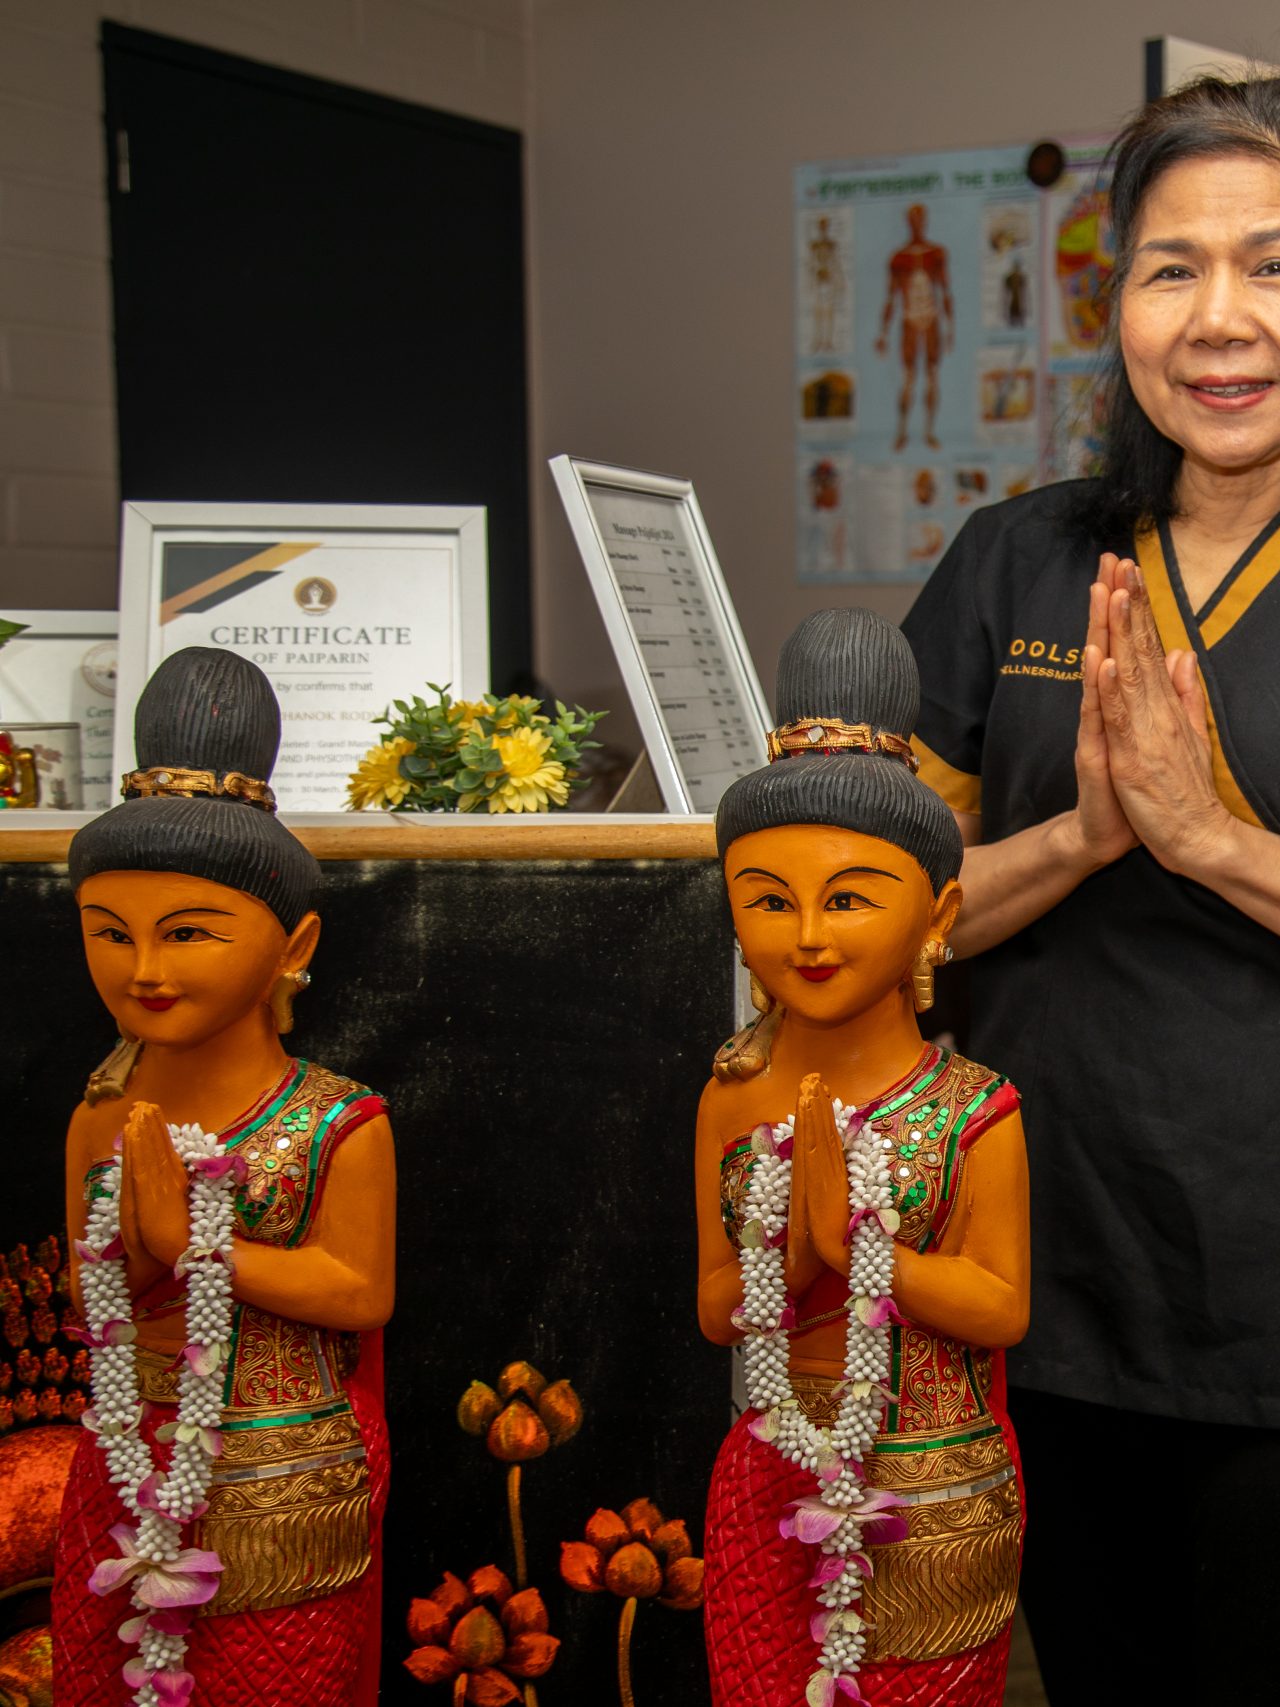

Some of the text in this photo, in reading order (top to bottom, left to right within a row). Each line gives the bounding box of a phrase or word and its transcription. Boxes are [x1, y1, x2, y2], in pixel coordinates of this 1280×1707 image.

[210, 626, 412, 645] CERTIFICATE
[252, 652, 370, 664] OF PAIPARIN
[348, 681, 373, 691] that
[282, 711, 336, 721] HANOK
